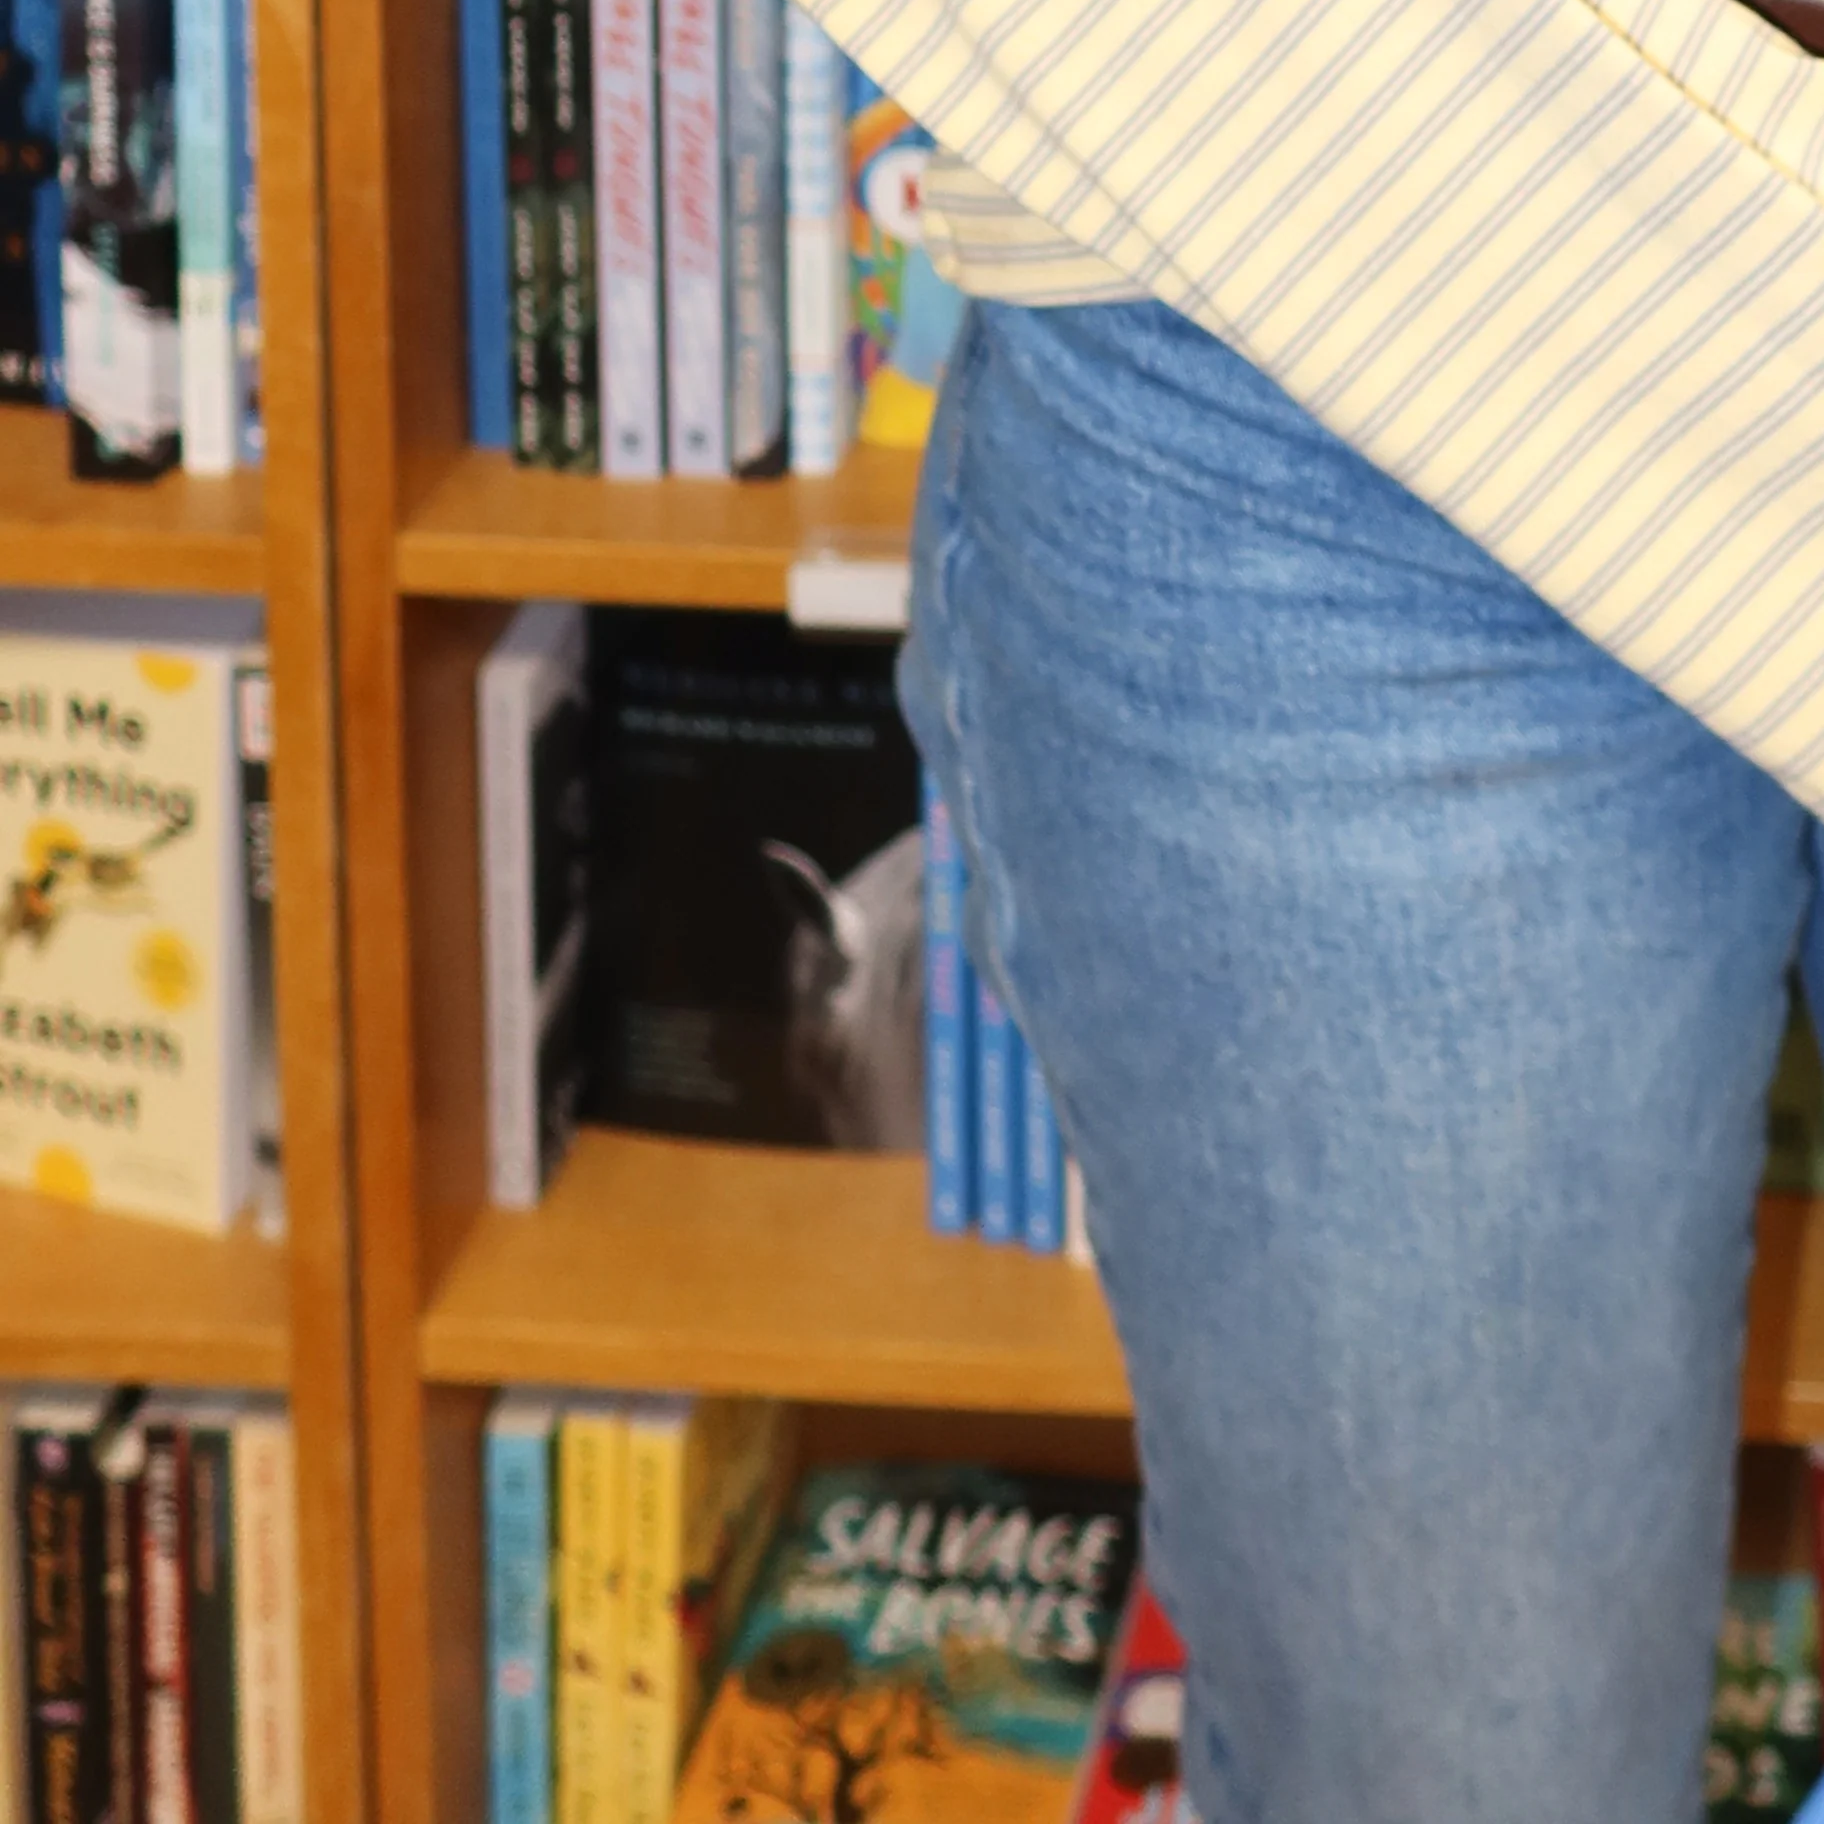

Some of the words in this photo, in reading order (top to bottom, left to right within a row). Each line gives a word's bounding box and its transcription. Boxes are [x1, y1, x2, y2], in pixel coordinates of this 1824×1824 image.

[64, 690, 150, 754] Me
[803, 1494, 1124, 1590] SALVAGE
[868, 1579, 1097, 1662] BONES
